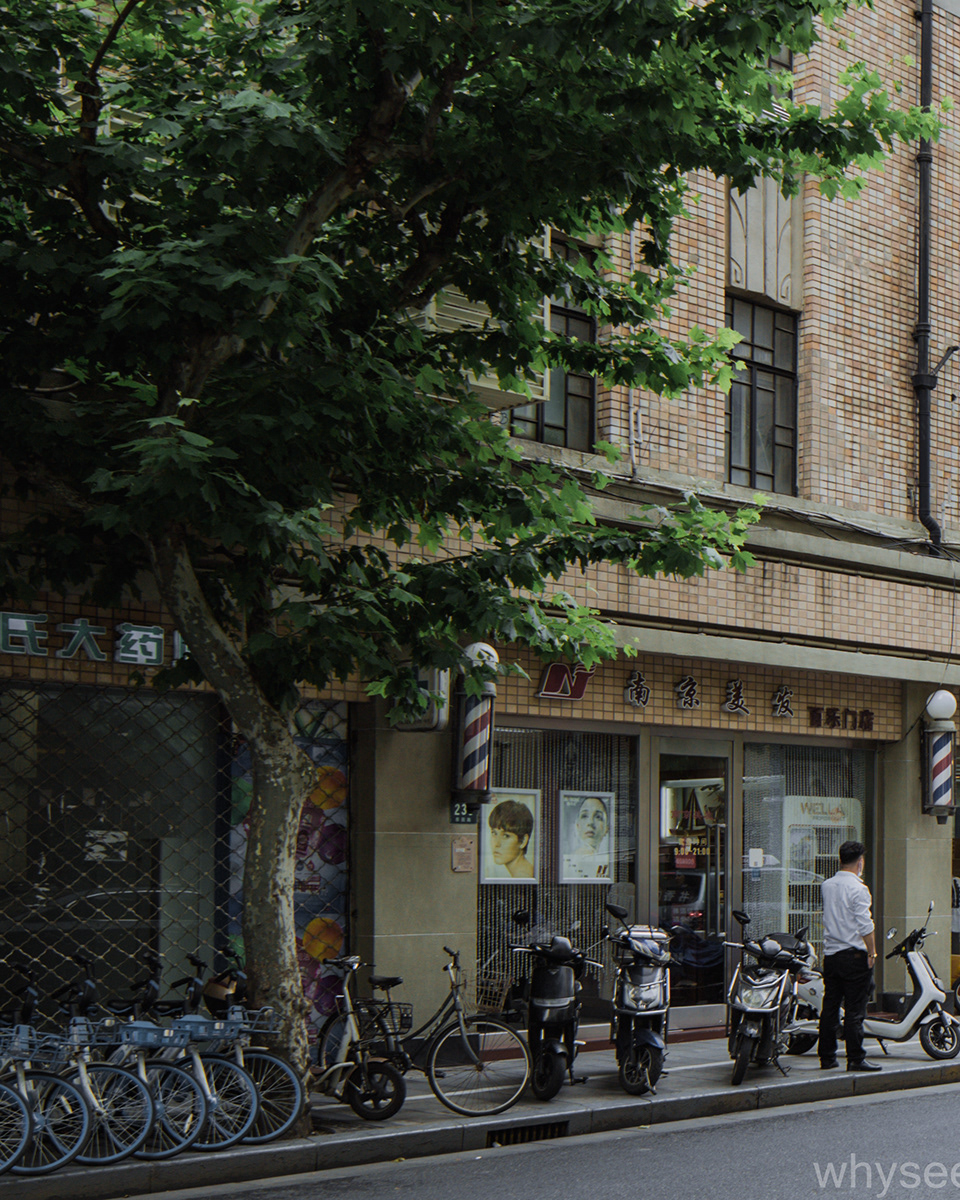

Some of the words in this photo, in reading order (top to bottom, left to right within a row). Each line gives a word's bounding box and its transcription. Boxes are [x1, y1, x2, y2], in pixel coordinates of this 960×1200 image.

[0, 611, 190, 669] 氏大药
[624, 670, 795, 718] 南京美发
